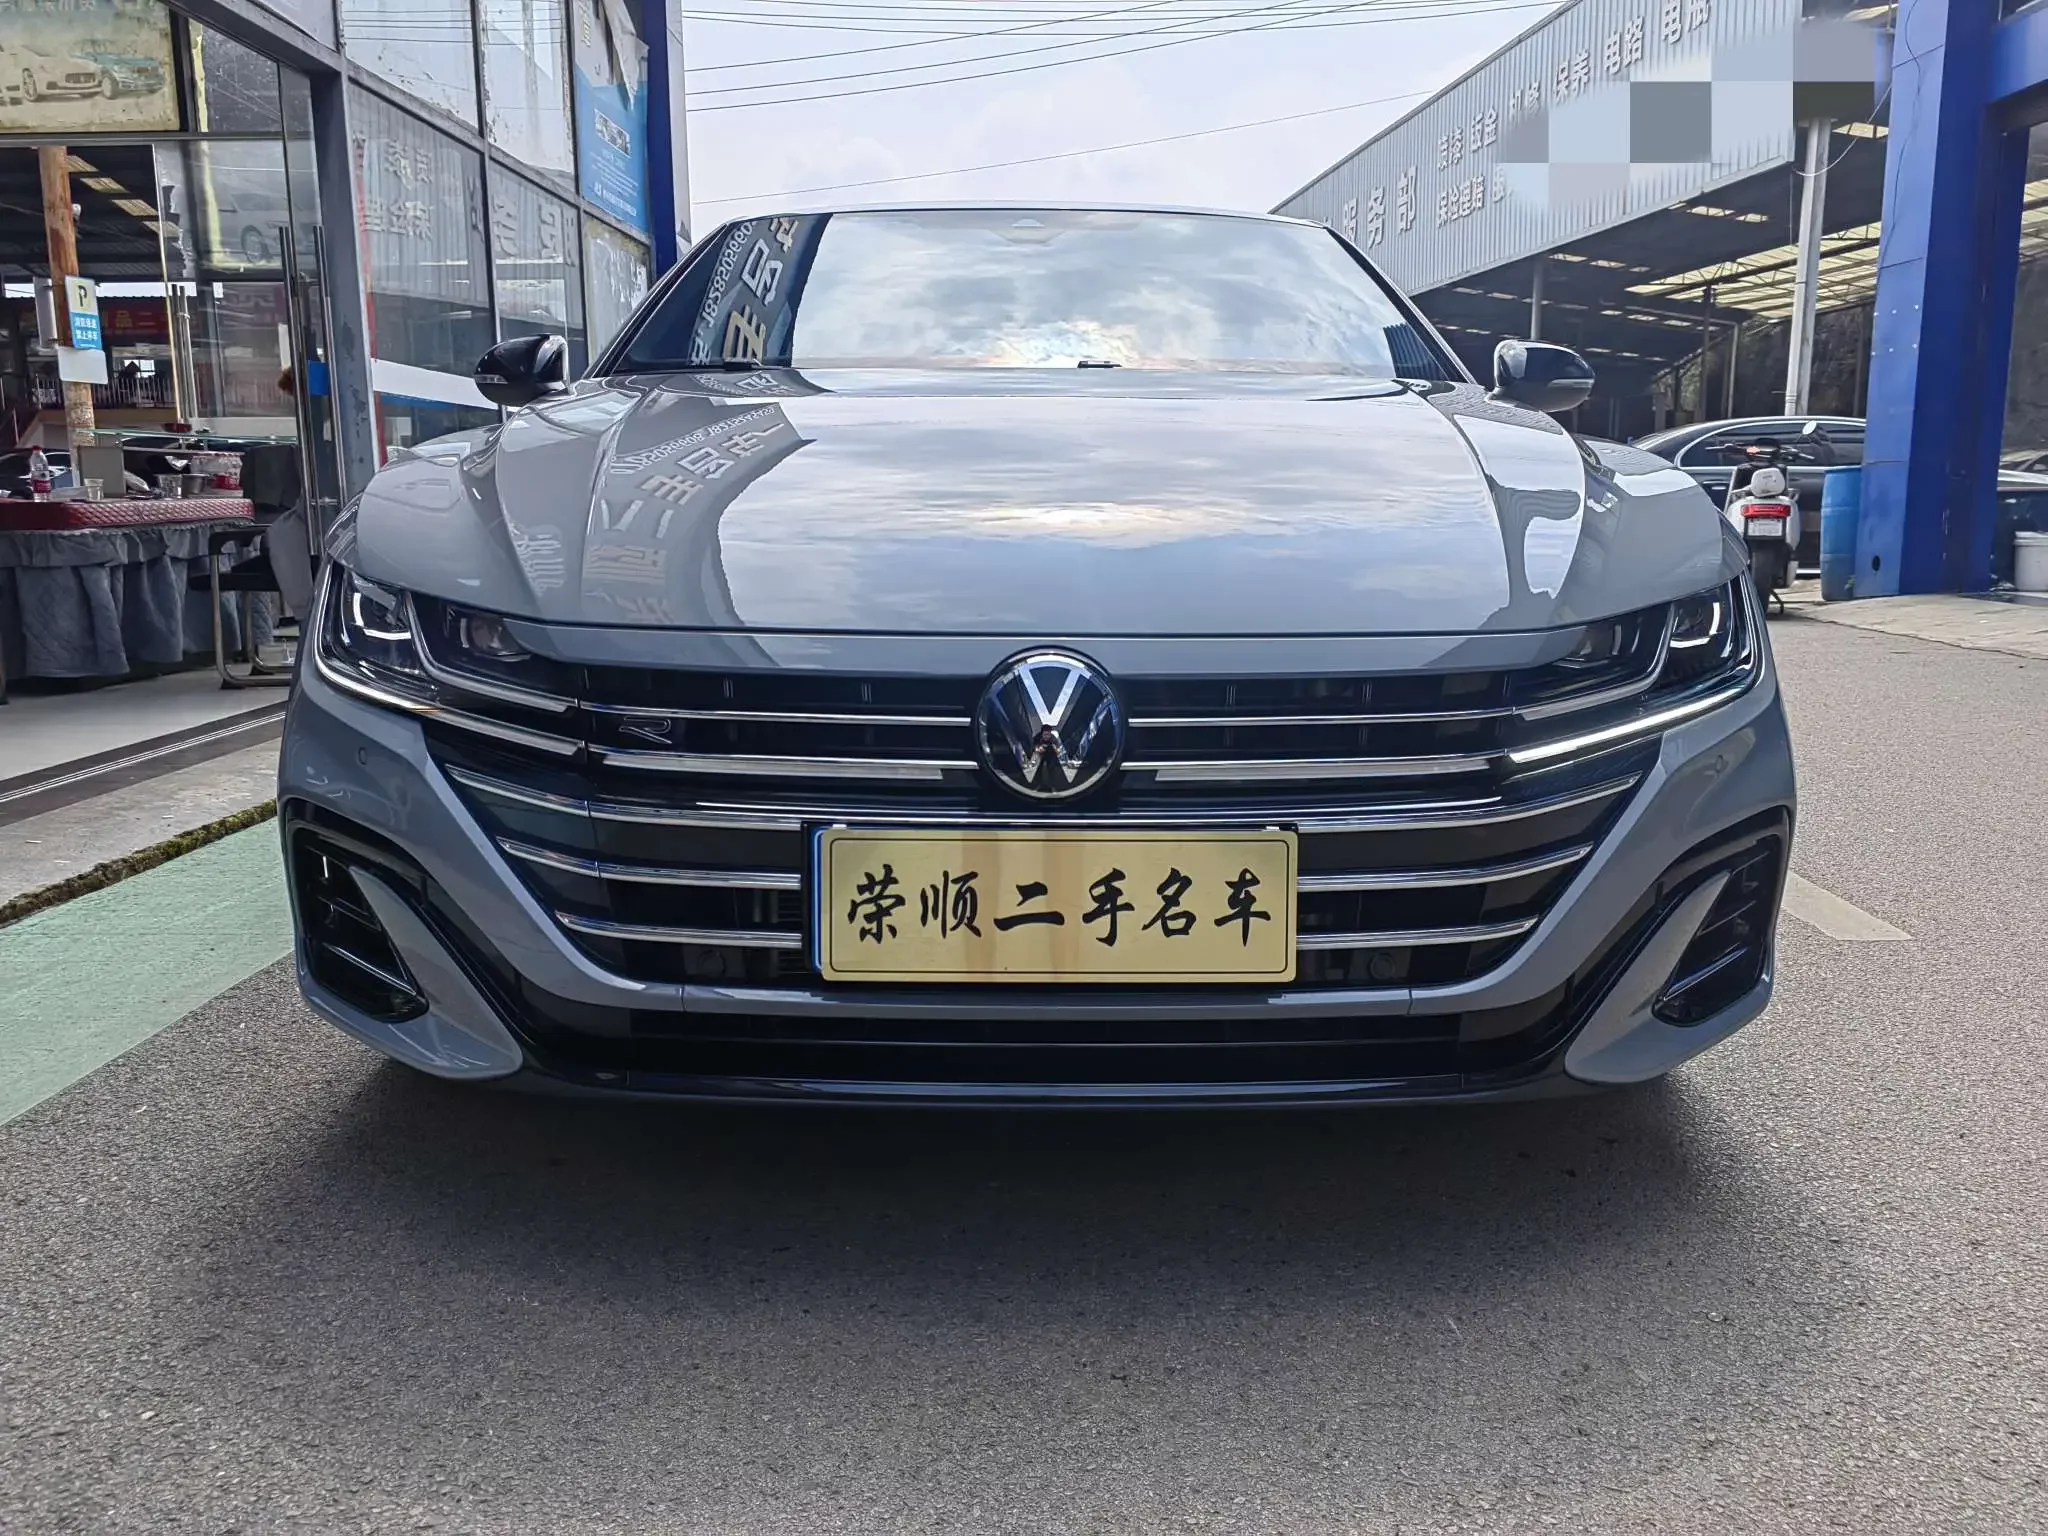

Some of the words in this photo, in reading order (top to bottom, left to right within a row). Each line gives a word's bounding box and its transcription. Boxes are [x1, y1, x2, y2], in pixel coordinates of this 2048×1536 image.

[1437, 128, 1464, 171] 喷漆
[1470, 105, 1498, 153] 钣金
[1554, 48, 1591, 104] 保养
[1604, 15, 1644, 75] 电路
[1324, 164, 1419, 251] 服务部
[1437, 174, 1486, 229] 保险理赔
[77, 285, 88, 307] P
[847, 862, 1272, 948] 荣顺二手名车
